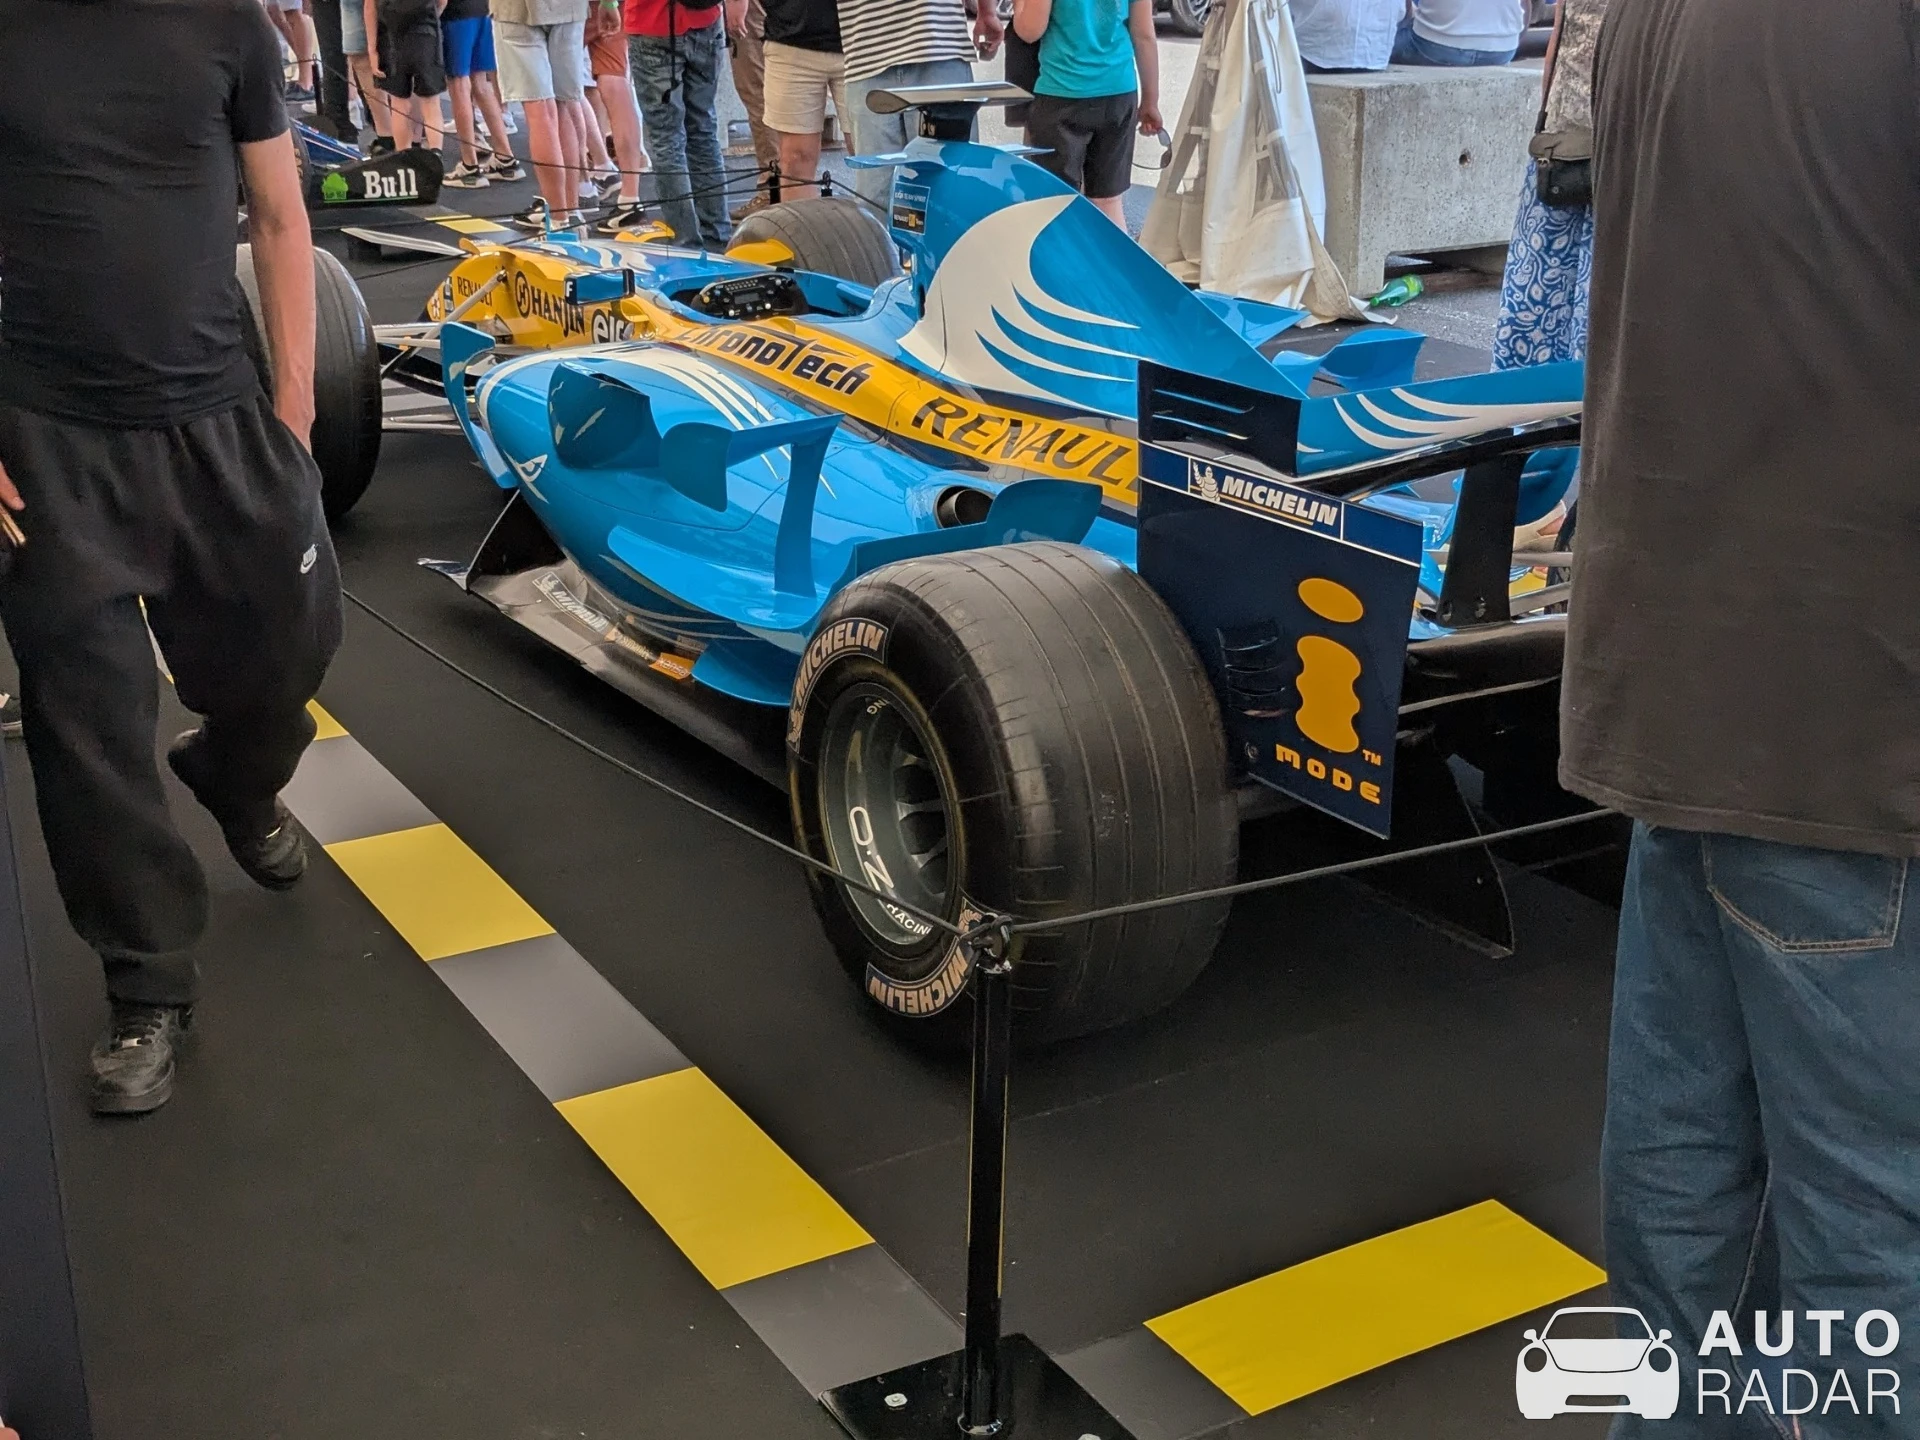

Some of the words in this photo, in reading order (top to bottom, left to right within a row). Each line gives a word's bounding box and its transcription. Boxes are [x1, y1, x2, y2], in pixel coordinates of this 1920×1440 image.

[362, 168, 419, 199] Bull
[911, 396, 1138, 494] RENAUL
[1221, 475, 1339, 526] MICHELIN
[795, 621, 884, 707] MICHELIN
[869, 945, 968, 1014] MICHELIN
